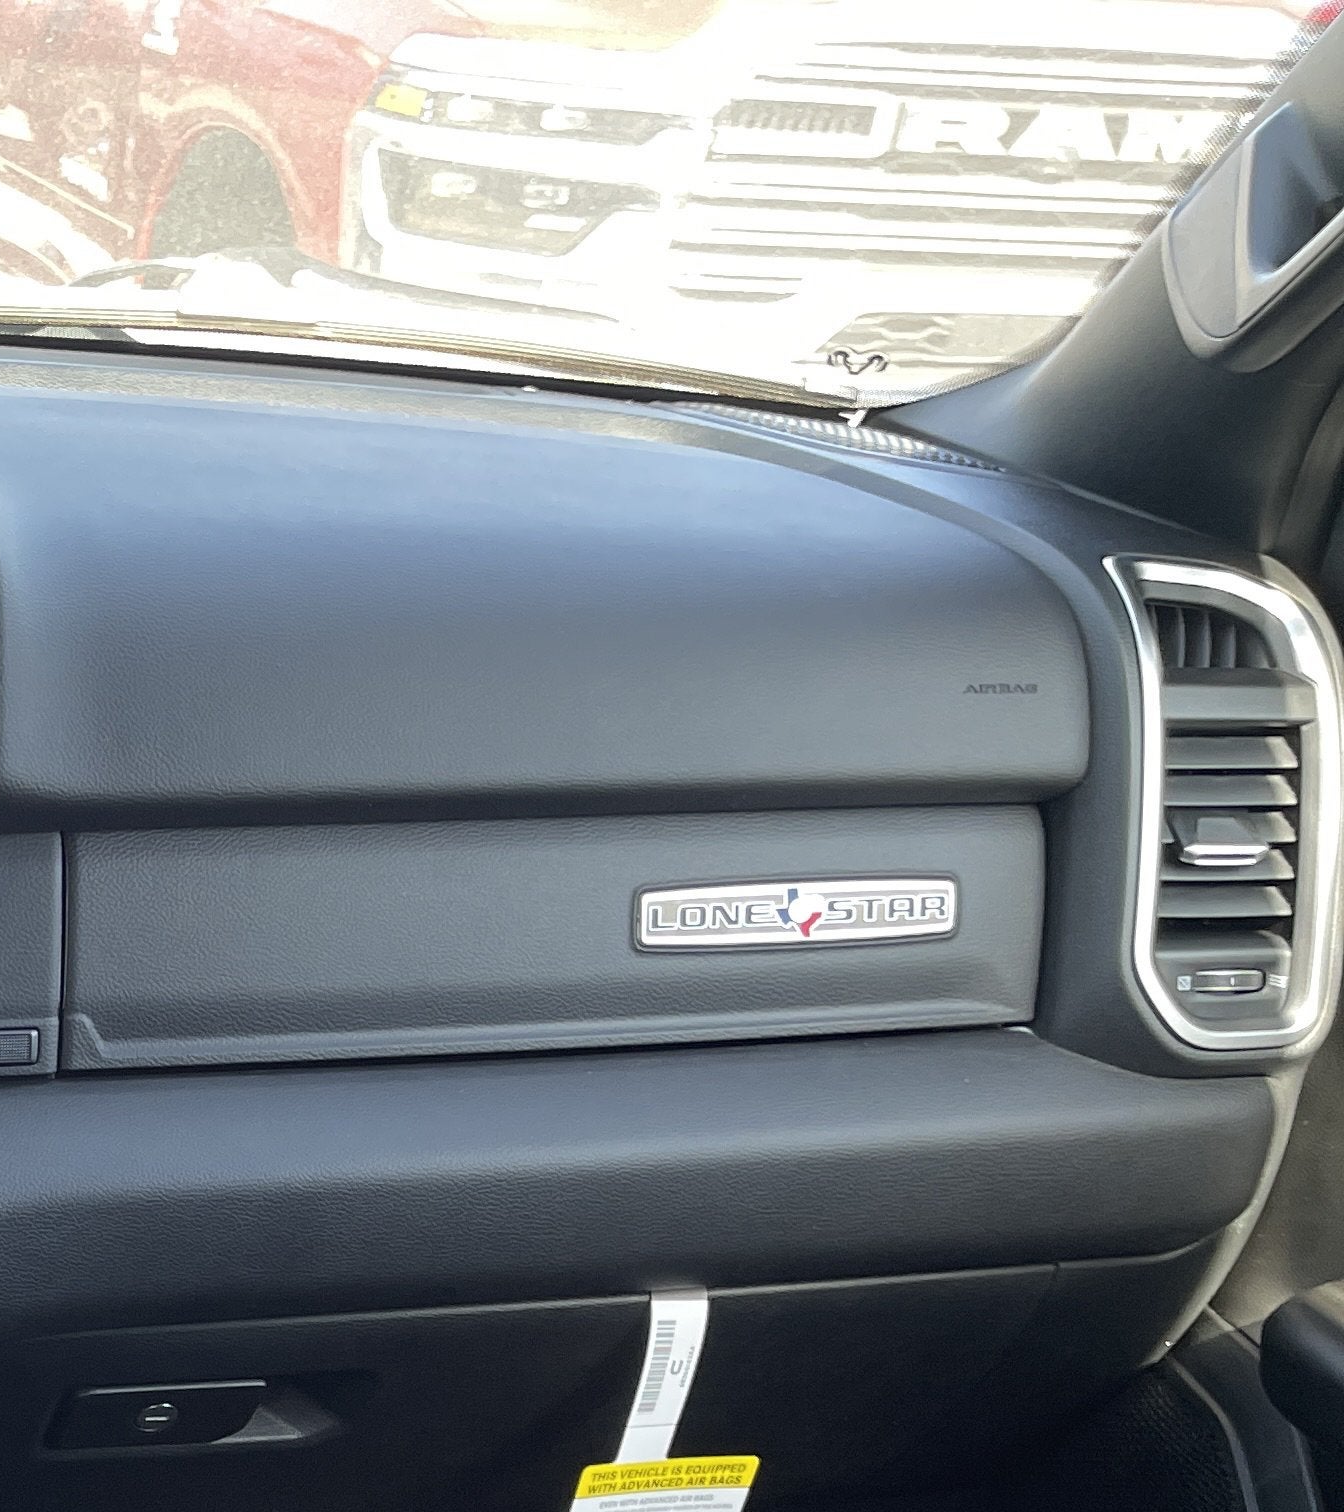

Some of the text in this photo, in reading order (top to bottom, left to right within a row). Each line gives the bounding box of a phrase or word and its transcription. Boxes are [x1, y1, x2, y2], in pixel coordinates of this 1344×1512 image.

[963, 683, 1038, 694] AIRBAG
[648, 894, 950, 931] LONE STAR
[591, 1462, 747, 1482] THIS VEHICLE IS EQUIPPED
[587, 1475, 742, 1494] WITH ADVANCED AIR BAGS
